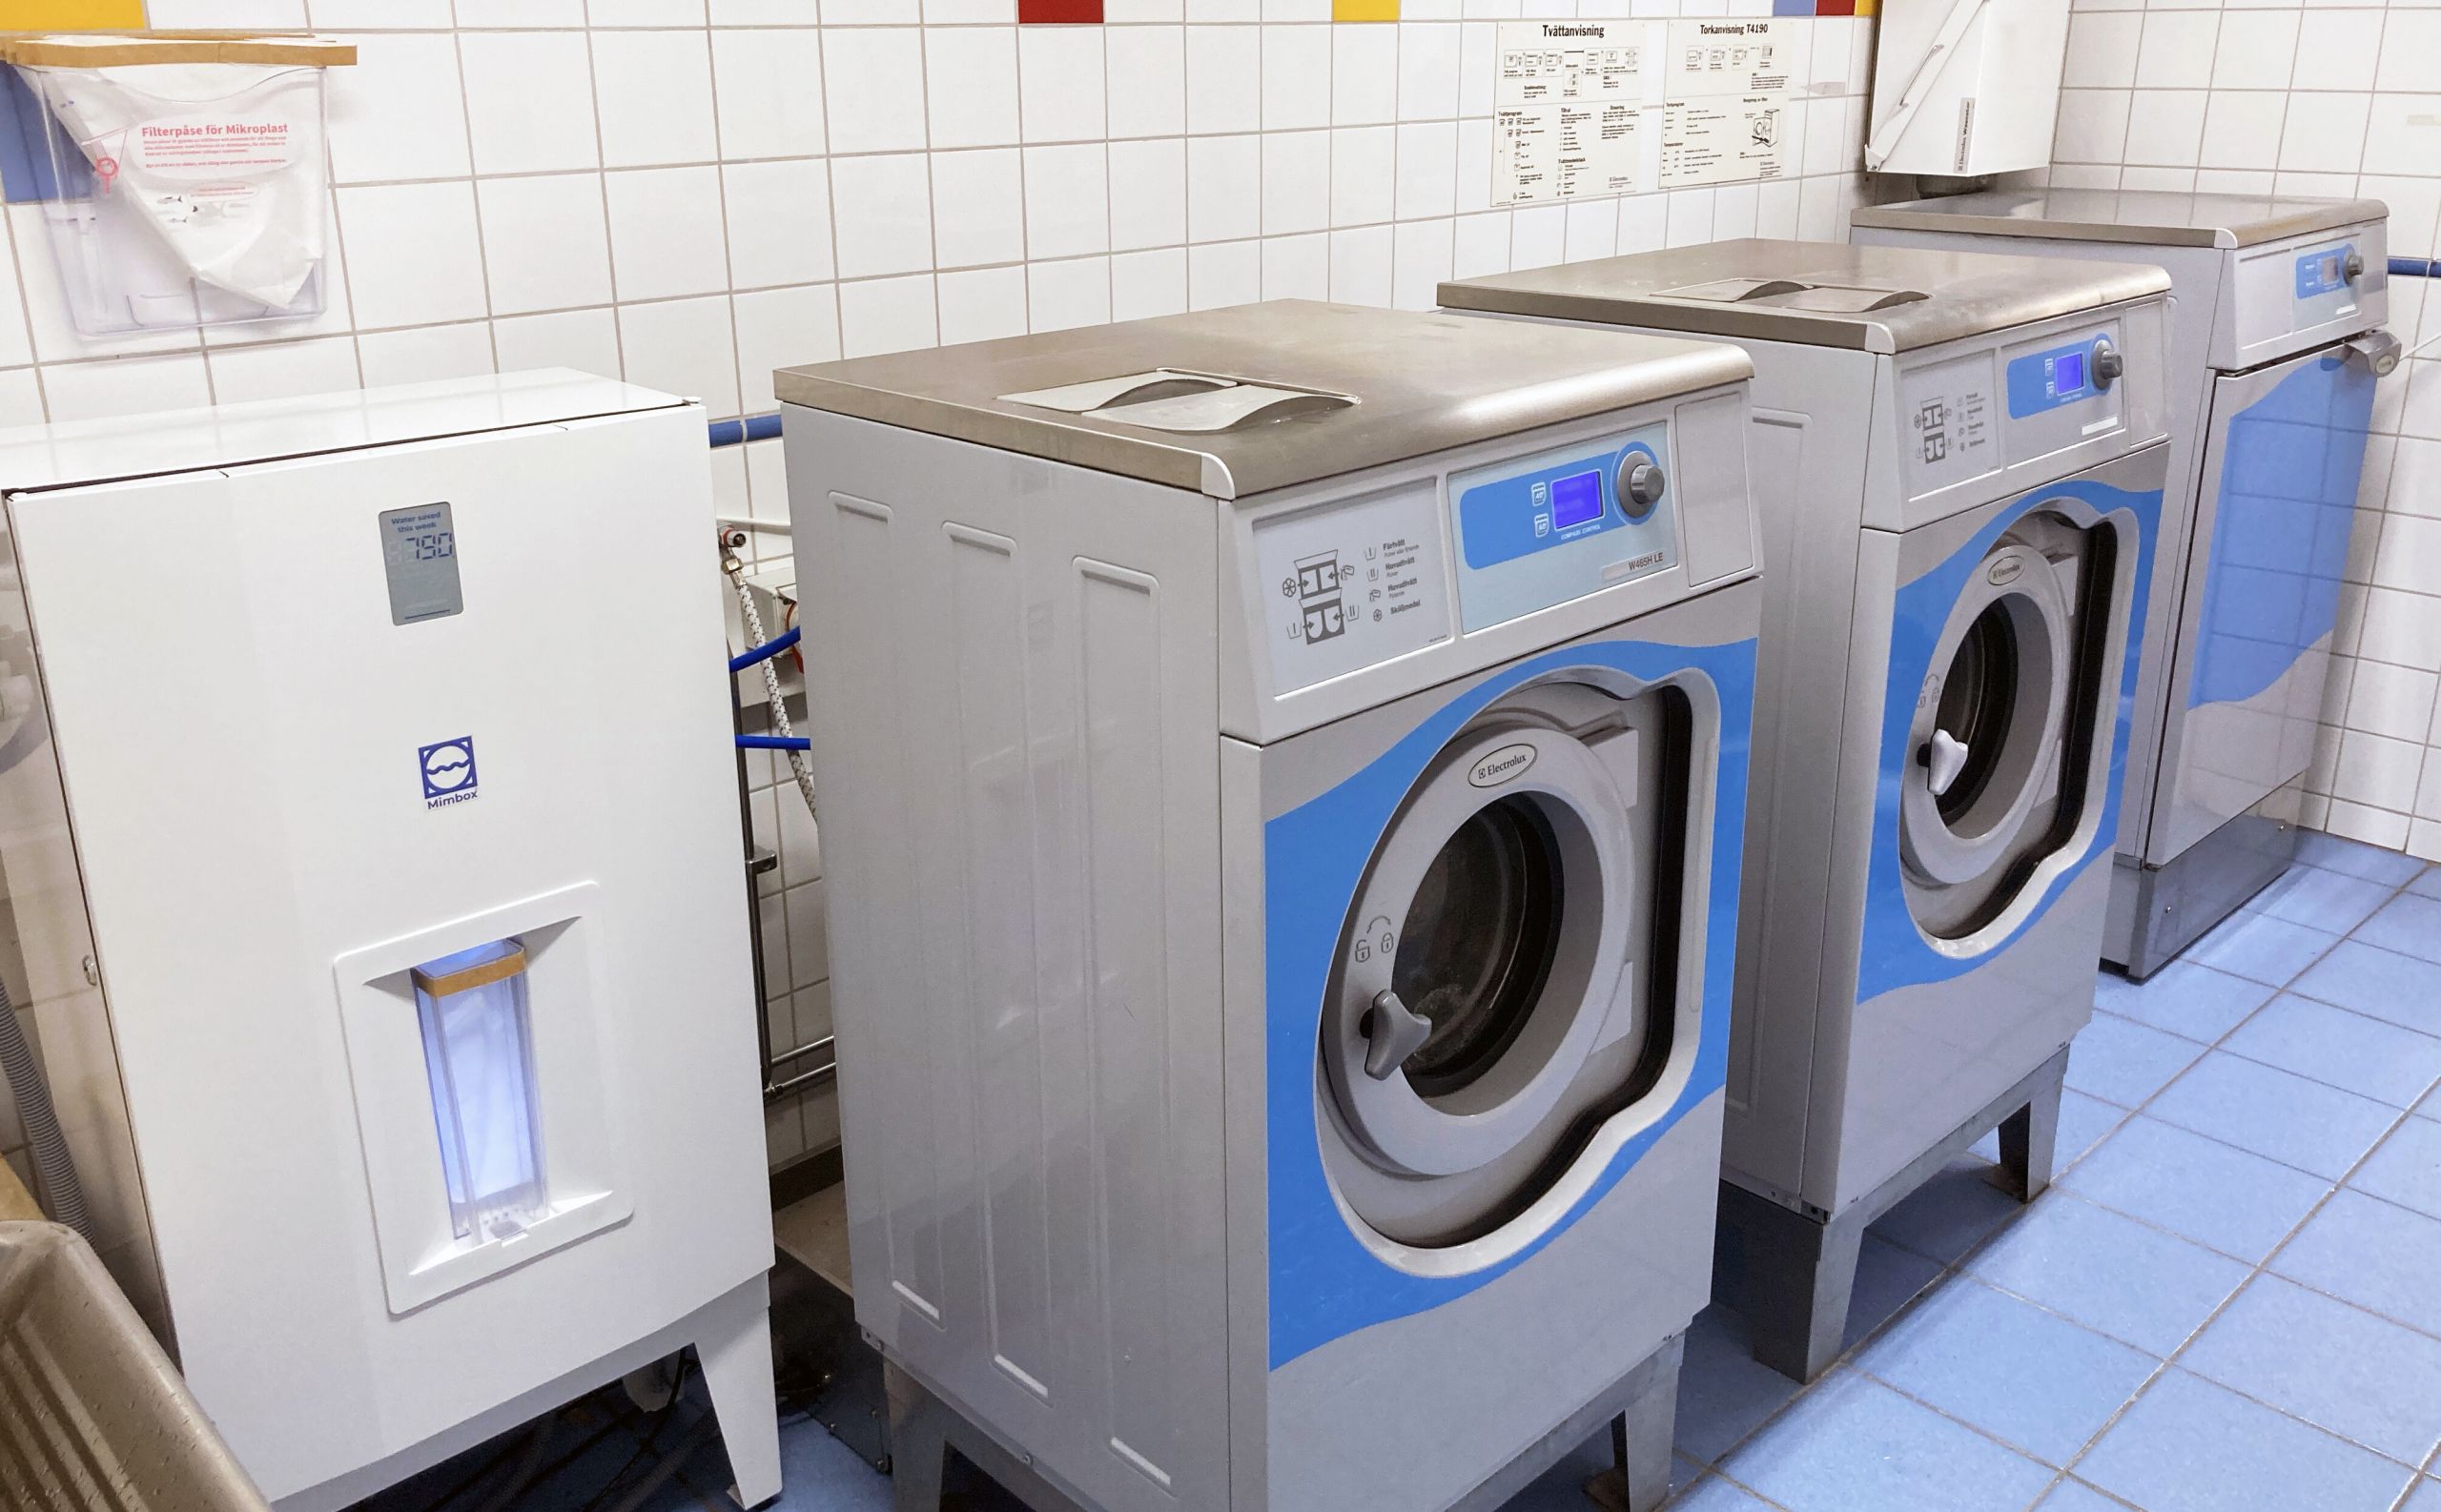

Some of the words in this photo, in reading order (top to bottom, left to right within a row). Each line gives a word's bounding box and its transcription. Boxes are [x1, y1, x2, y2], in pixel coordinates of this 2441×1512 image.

[1543, 25, 1605, 38] Tvättanvisning
[1700, 24, 1745, 35] Torkanvisning
[1747, 24, 1769, 33] T4190
[142, 125, 203, 137] Filterpåse
[206, 125, 223, 134] för
[226, 123, 288, 134] Mikroplast
[418, 511, 441, 521] saved
[415, 521, 437, 530] week
[406, 532, 453, 560] 790
[1629, 555, 1652, 571] W465H
[1653, 552, 1664, 562] LE
[1487, 755, 1527, 775] Electrolux
[427, 790, 478, 809] Mimbox
